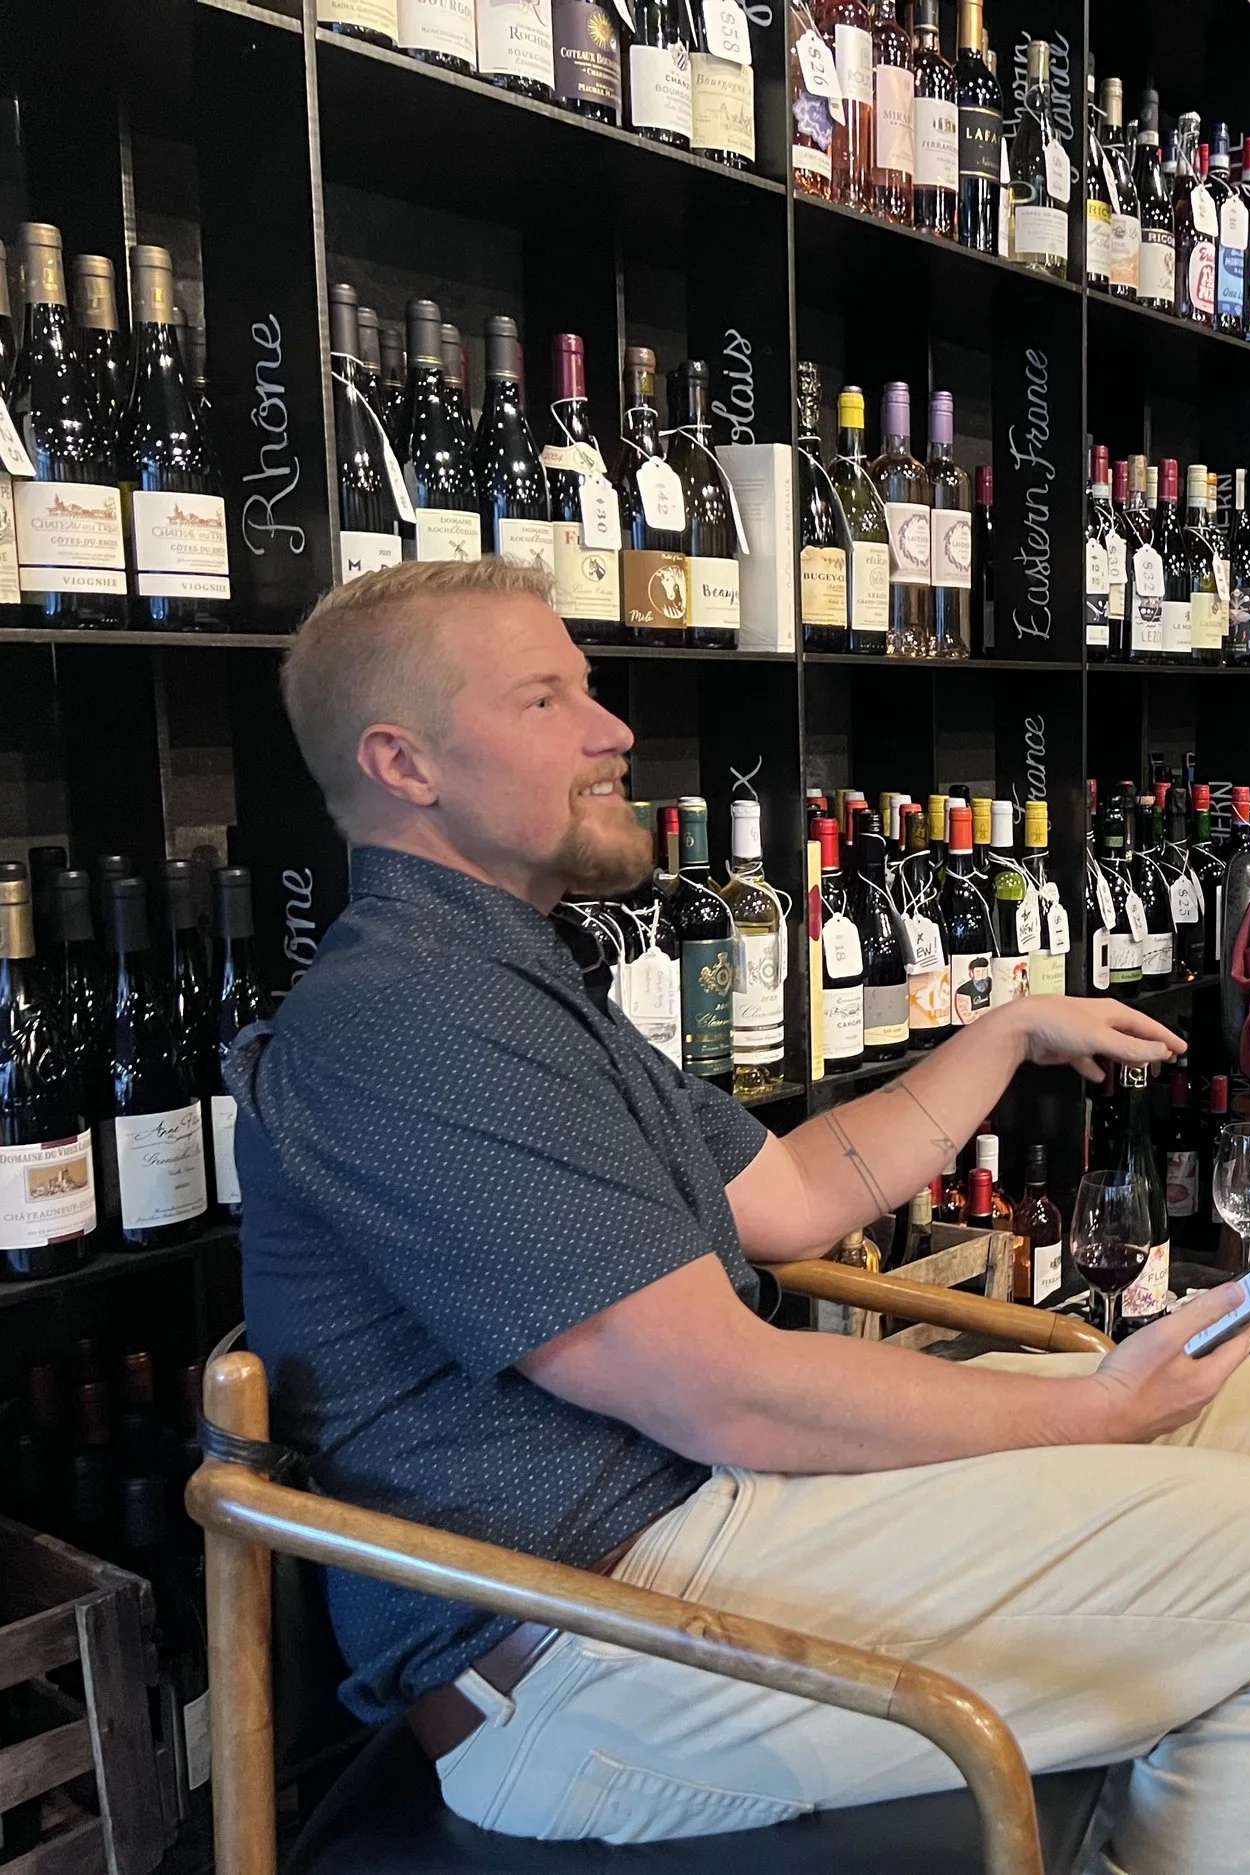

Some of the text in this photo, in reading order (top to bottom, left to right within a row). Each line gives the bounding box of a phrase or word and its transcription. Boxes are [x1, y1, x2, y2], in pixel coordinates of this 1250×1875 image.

[242, 313, 305, 555] Rhône
[711, 329, 755, 446] olais
[1008, 347, 1056, 642] Eastern France
